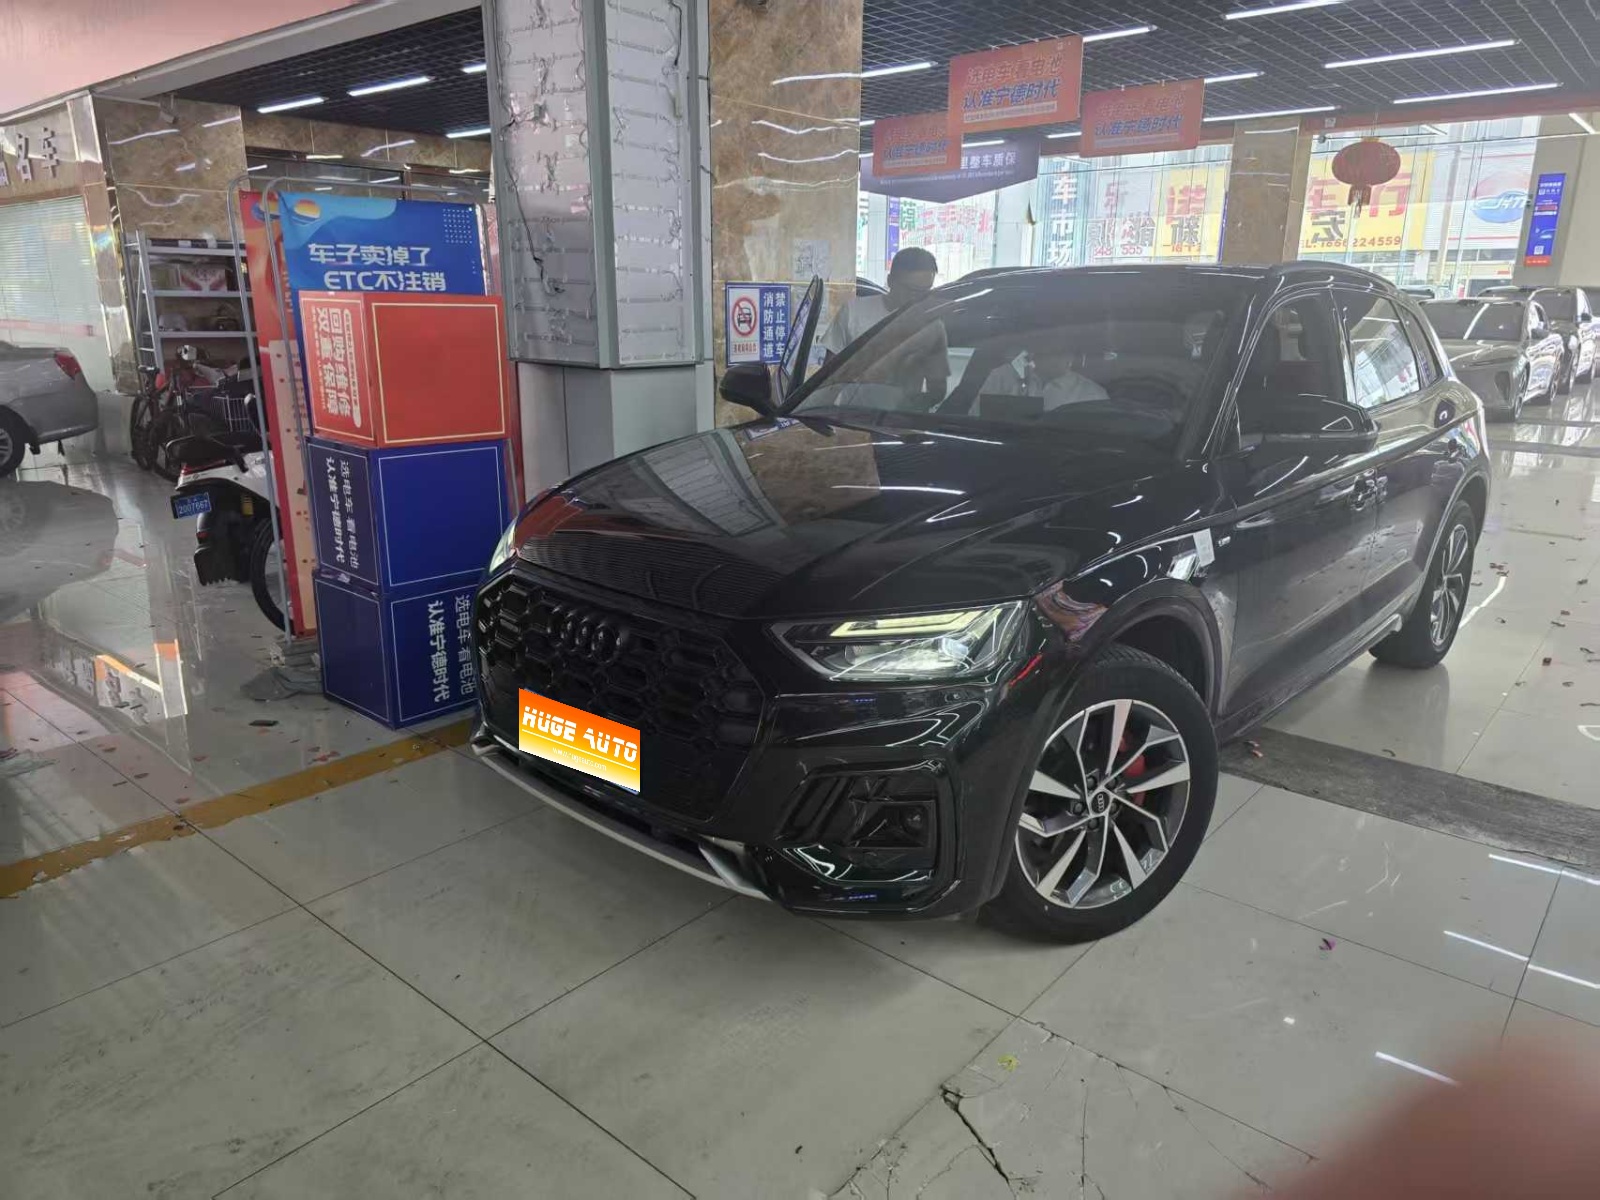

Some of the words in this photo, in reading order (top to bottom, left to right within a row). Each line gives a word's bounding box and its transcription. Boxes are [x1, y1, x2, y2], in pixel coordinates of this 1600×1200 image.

[962, 78, 1061, 110] 认准宁德时代
[307, 243, 431, 267] 车子卖掉了
[324, 270, 447, 292] ETC不注销
[763, 292, 774, 359] 消防通道
[775, 292, 786, 358] 禁止停车
[325, 456, 346, 564] 认准宁德时代
[427, 599, 451, 703] 认准宁德时代
